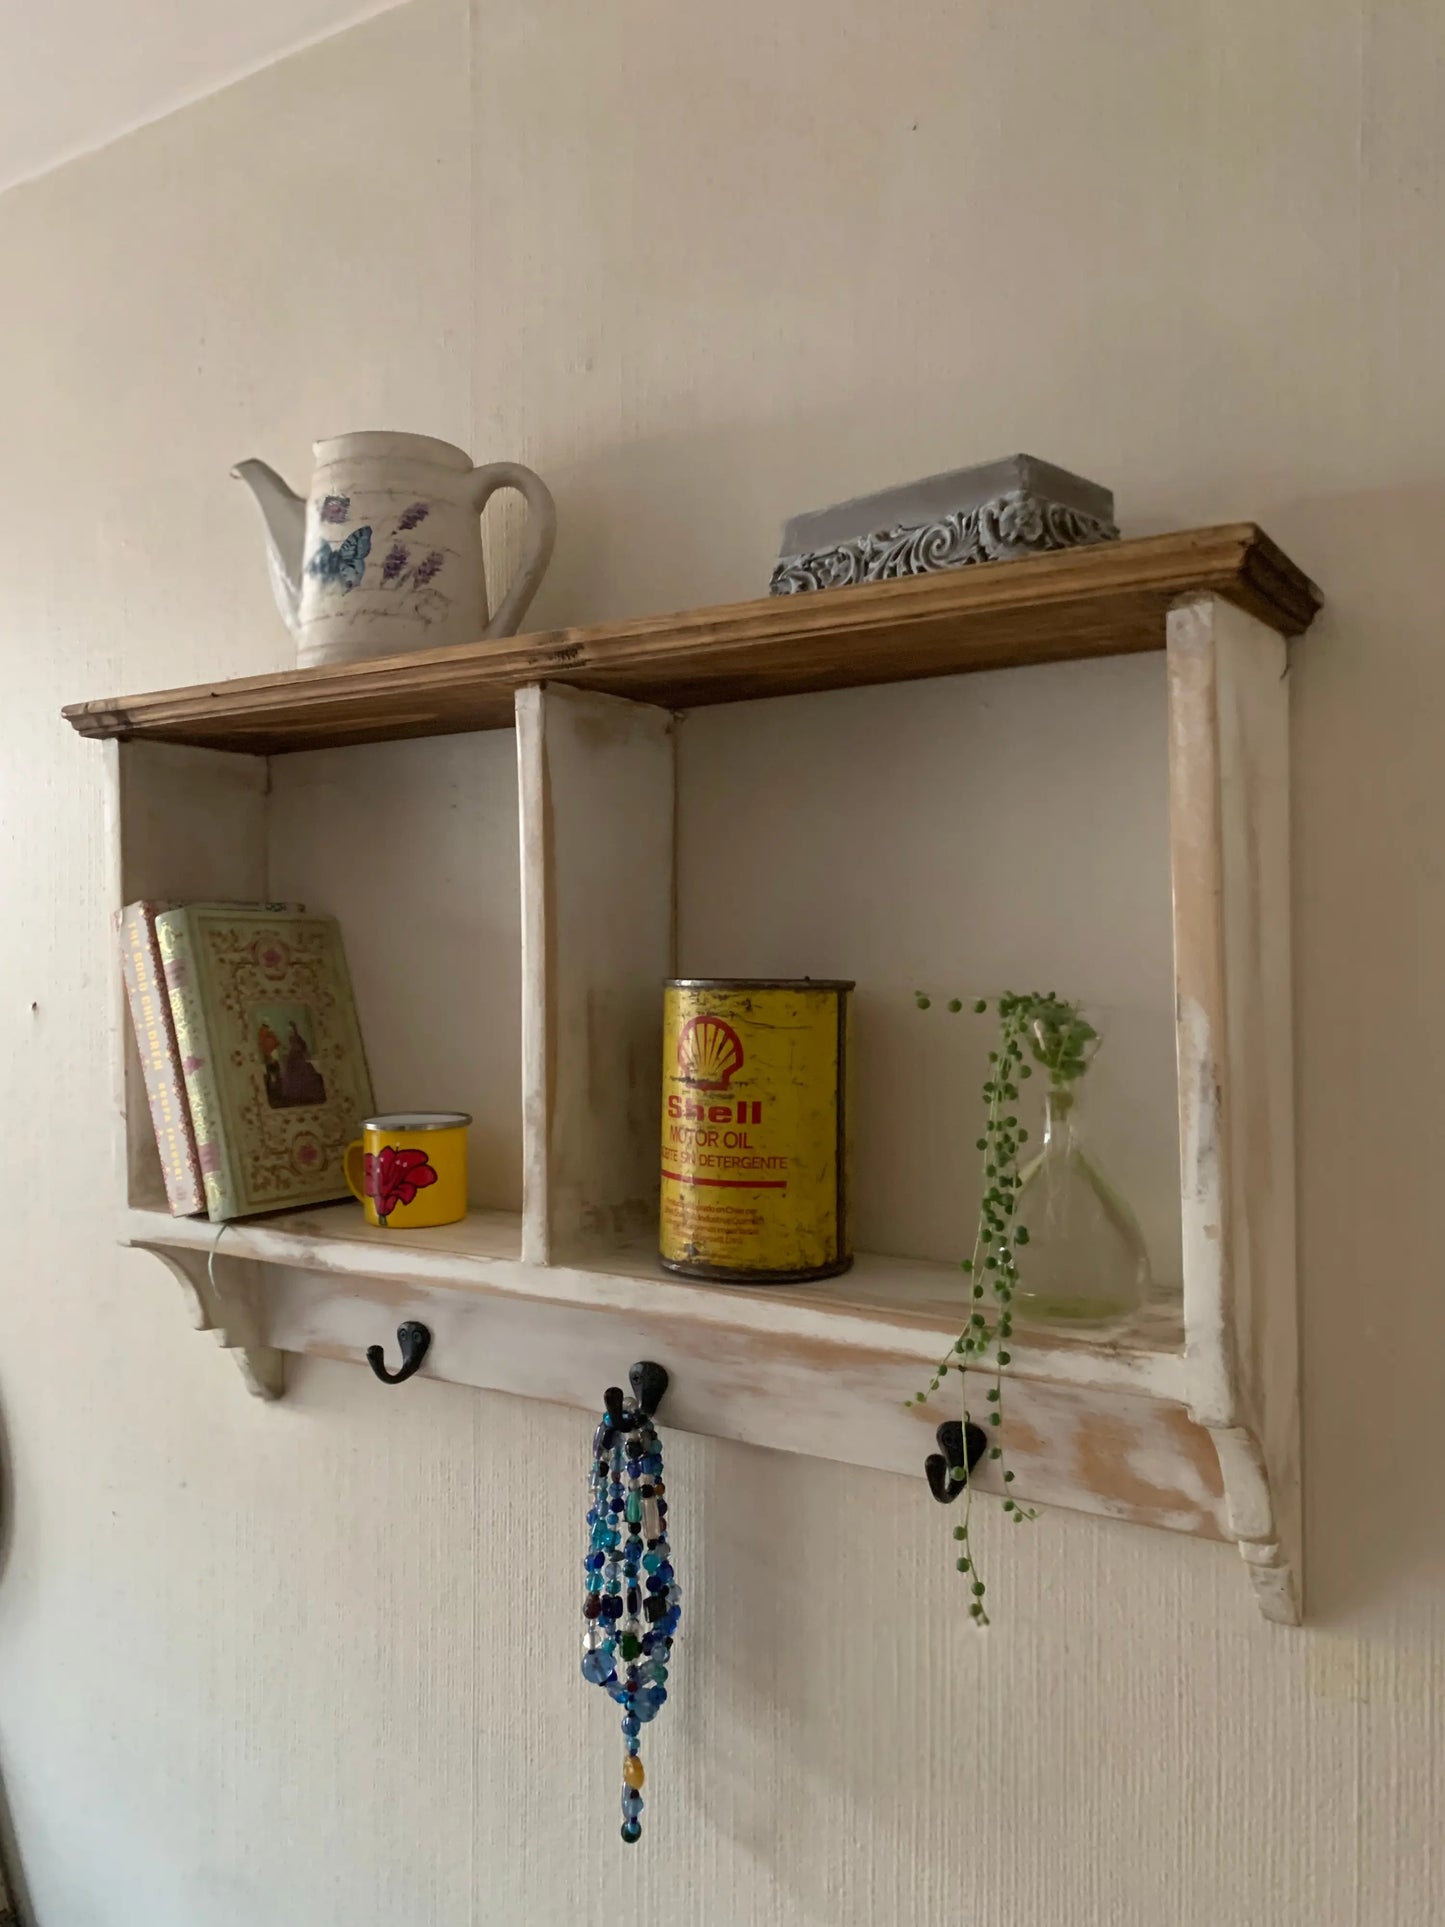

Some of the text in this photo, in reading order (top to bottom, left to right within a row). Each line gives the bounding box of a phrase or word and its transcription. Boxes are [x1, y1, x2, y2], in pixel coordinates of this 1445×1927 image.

[128, 922, 140, 947] THE
[133, 952, 148, 991] GOOD
[141, 995, 163, 1071] CHILDREN
[668, 1095, 762, 1124] Shell
[671, 1125, 753, 1149] MOTOR OIL
[680, 1151, 696, 1164] SIN
[699, 1155, 787, 1169] DETERGENTE
